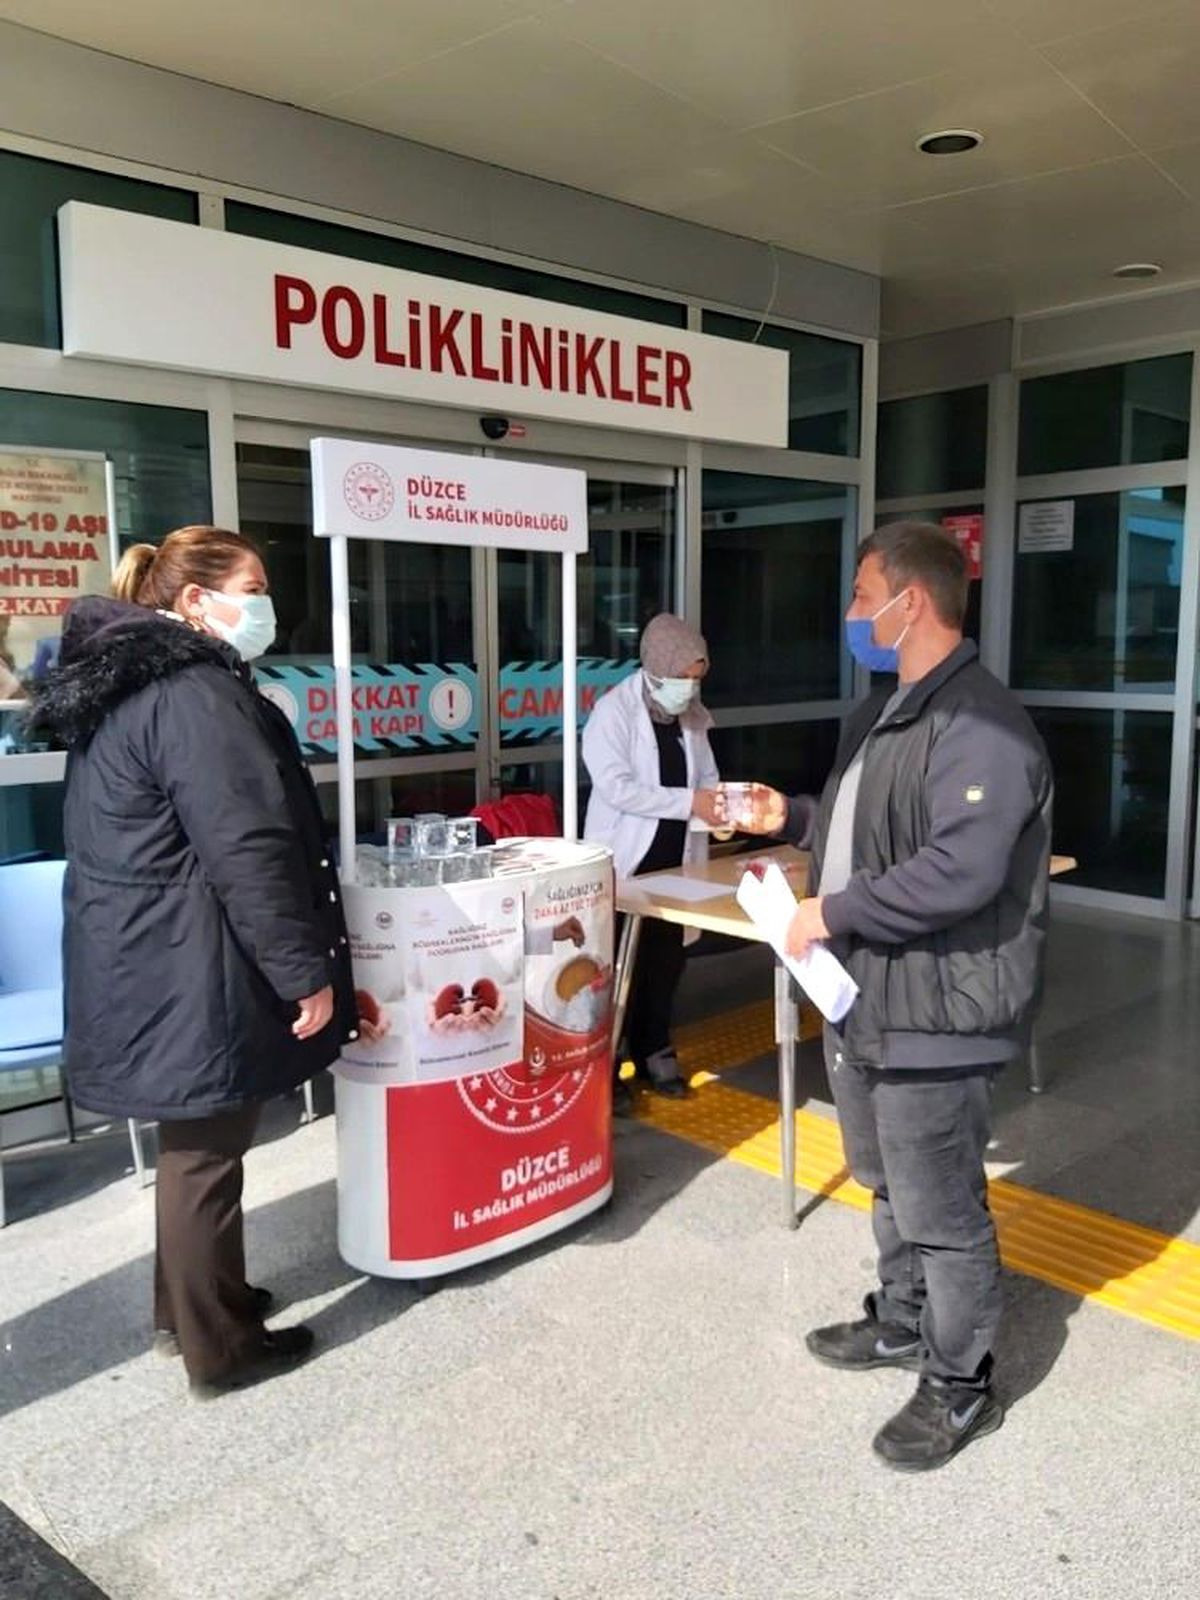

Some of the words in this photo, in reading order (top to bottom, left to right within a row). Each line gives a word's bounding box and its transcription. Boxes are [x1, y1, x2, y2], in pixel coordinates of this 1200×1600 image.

[407, 475, 467, 500] DÜZCE
[64, 513, 109, 538] AŞI
[408, 499, 422, 519] İL
[426, 504, 478, 525] SAĞLIK
[482, 508, 569, 532] MÜDÜRLÜĞÜ
[371, 713, 424, 737] KAPI
[501, 1146, 570, 1192] DÜZCE
[453, 1210, 469, 1230] İL
[472, 1192, 526, 1226] SAĞLIK
